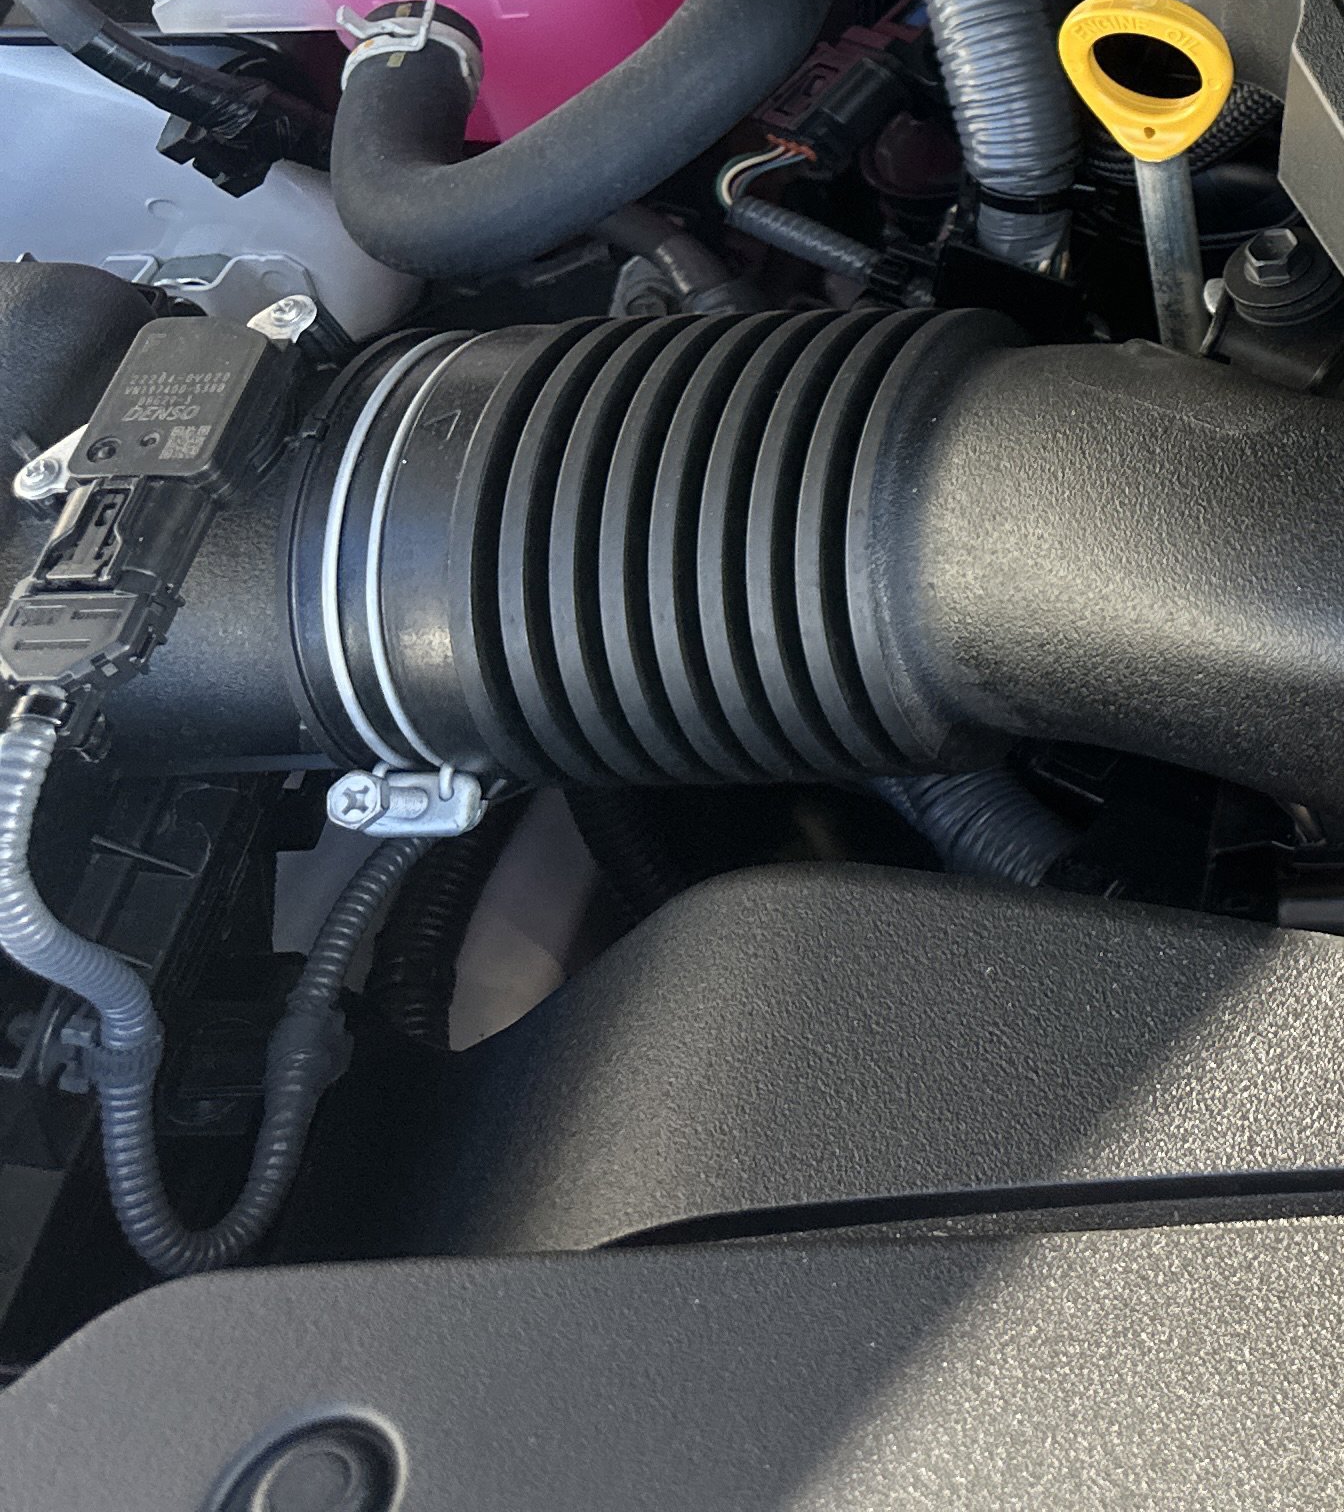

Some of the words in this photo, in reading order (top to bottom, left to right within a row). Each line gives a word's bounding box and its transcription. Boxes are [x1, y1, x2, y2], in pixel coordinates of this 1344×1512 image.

[1070, 14, 1150, 40] ENGINE
[1166, 29, 1201, 54] OIL
[121, 405, 201, 422] DENSO
